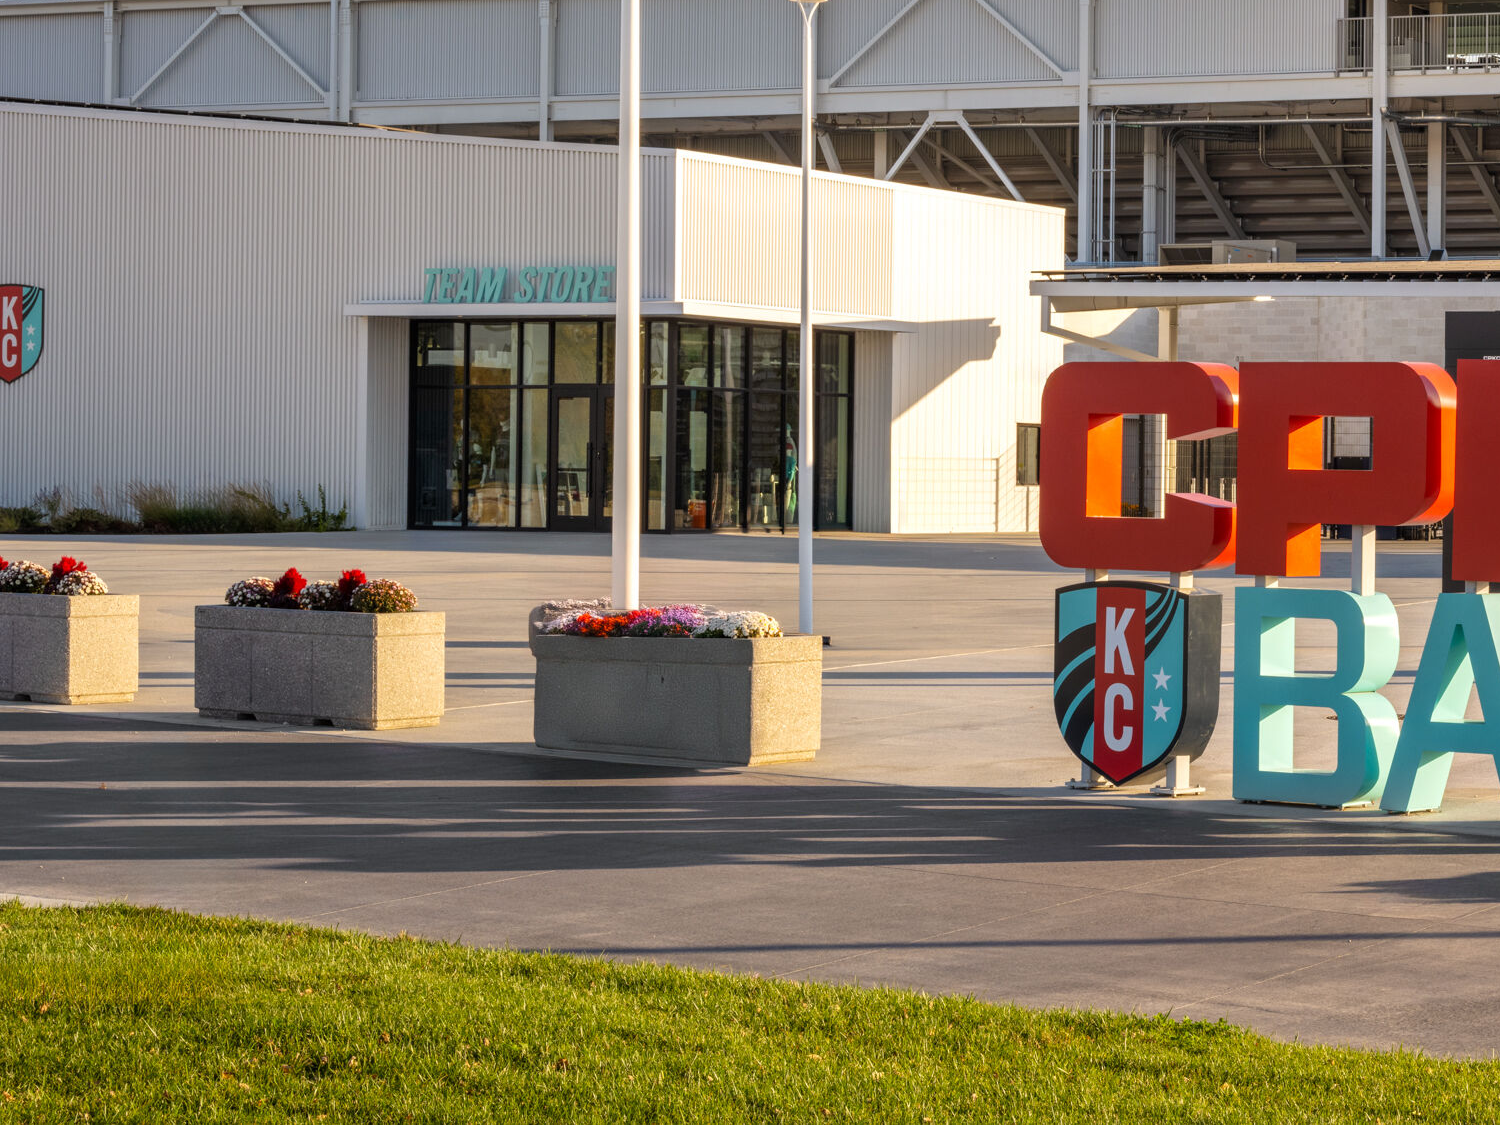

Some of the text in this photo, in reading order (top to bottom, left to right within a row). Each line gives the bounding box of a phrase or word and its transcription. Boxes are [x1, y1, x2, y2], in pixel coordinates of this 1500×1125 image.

[423, 265, 616, 304] TEAM STORE
[1, 295, 19, 369] KC
[1103, 606, 1137, 753] KC
